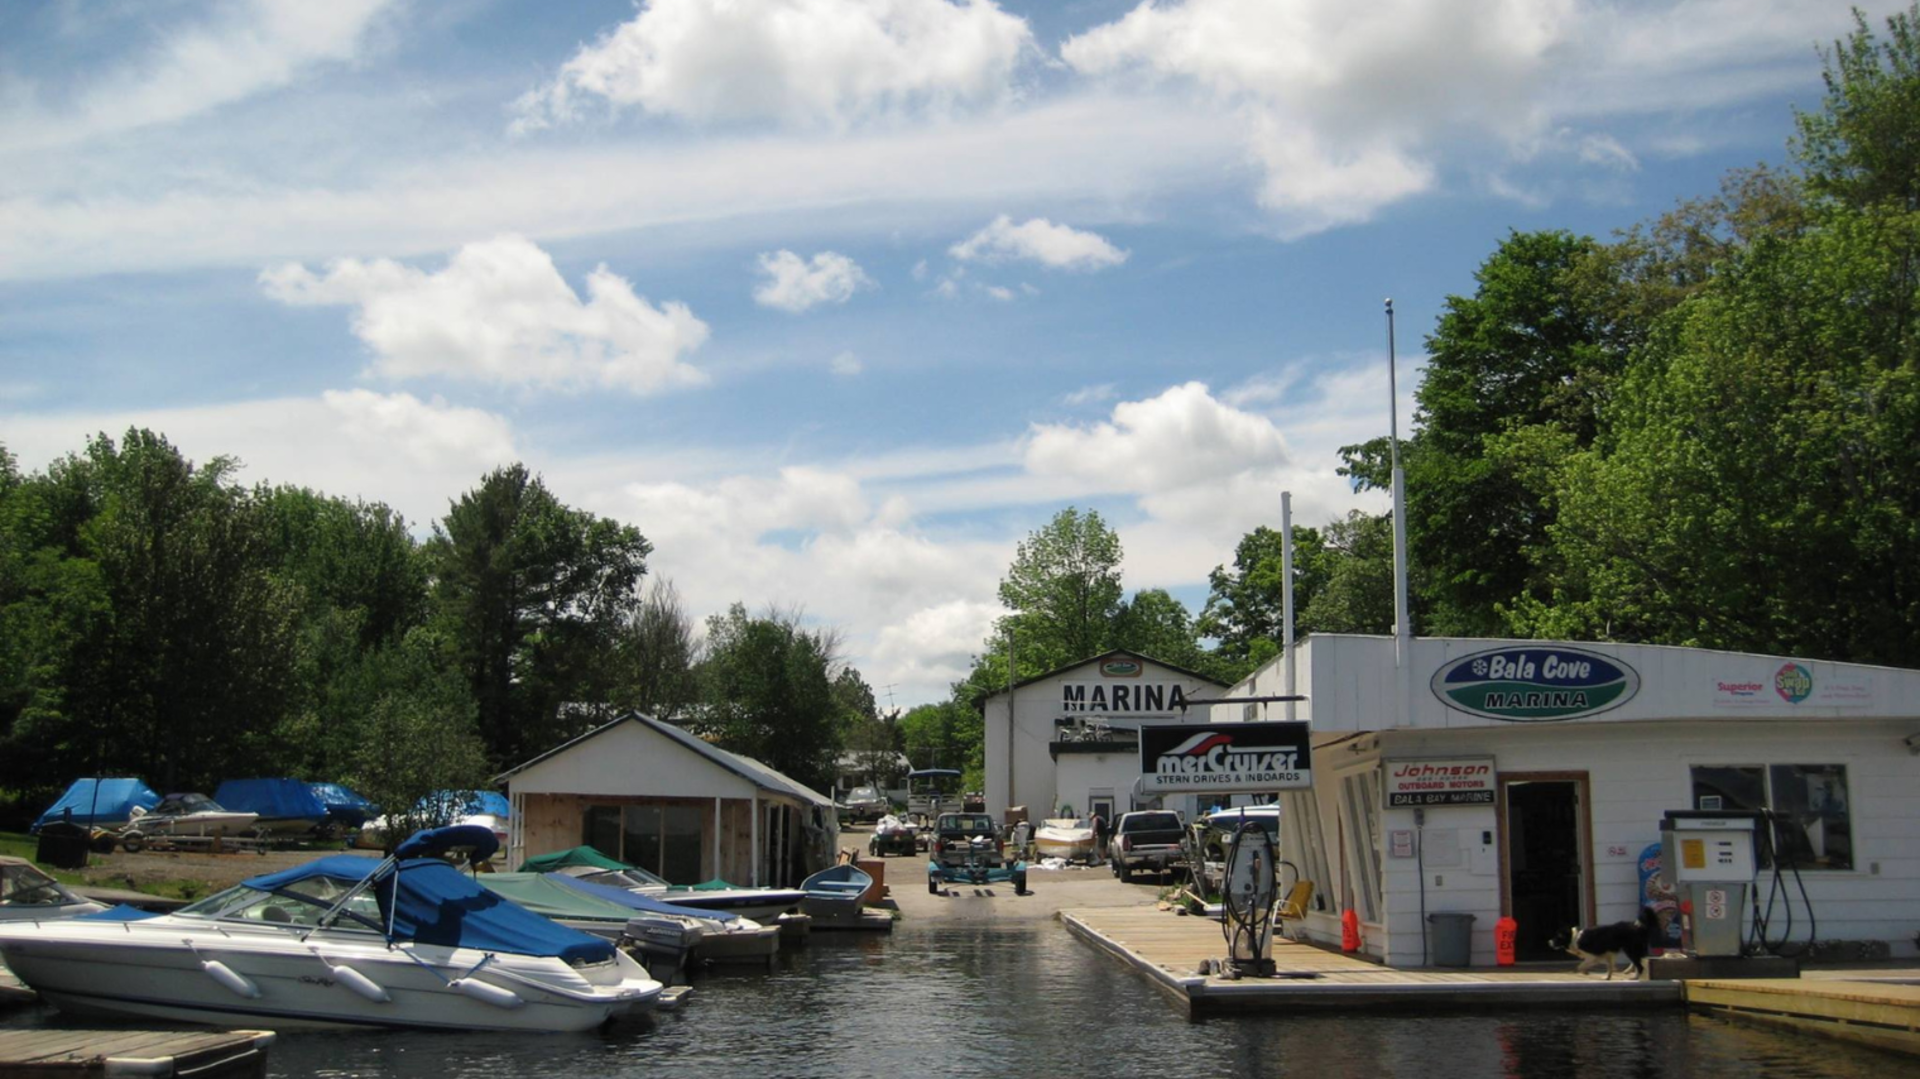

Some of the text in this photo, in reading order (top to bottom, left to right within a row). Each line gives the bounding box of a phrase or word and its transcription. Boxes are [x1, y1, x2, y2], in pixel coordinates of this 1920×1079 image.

[1488, 653, 1590, 679] Bala Cove
[1717, 681, 1763, 695] Superior
[1063, 684, 1188, 711] MARINA
[1484, 690, 1589, 709] MARINA
[1394, 764, 1489, 777] Johnson
[1156, 772, 1300, 784] STERN DRIVES & INBOARDS
[1398, 780, 1485, 790] OUTBOARD MOTORS
[1393, 792, 1491, 804] BALA BAY MARINE
